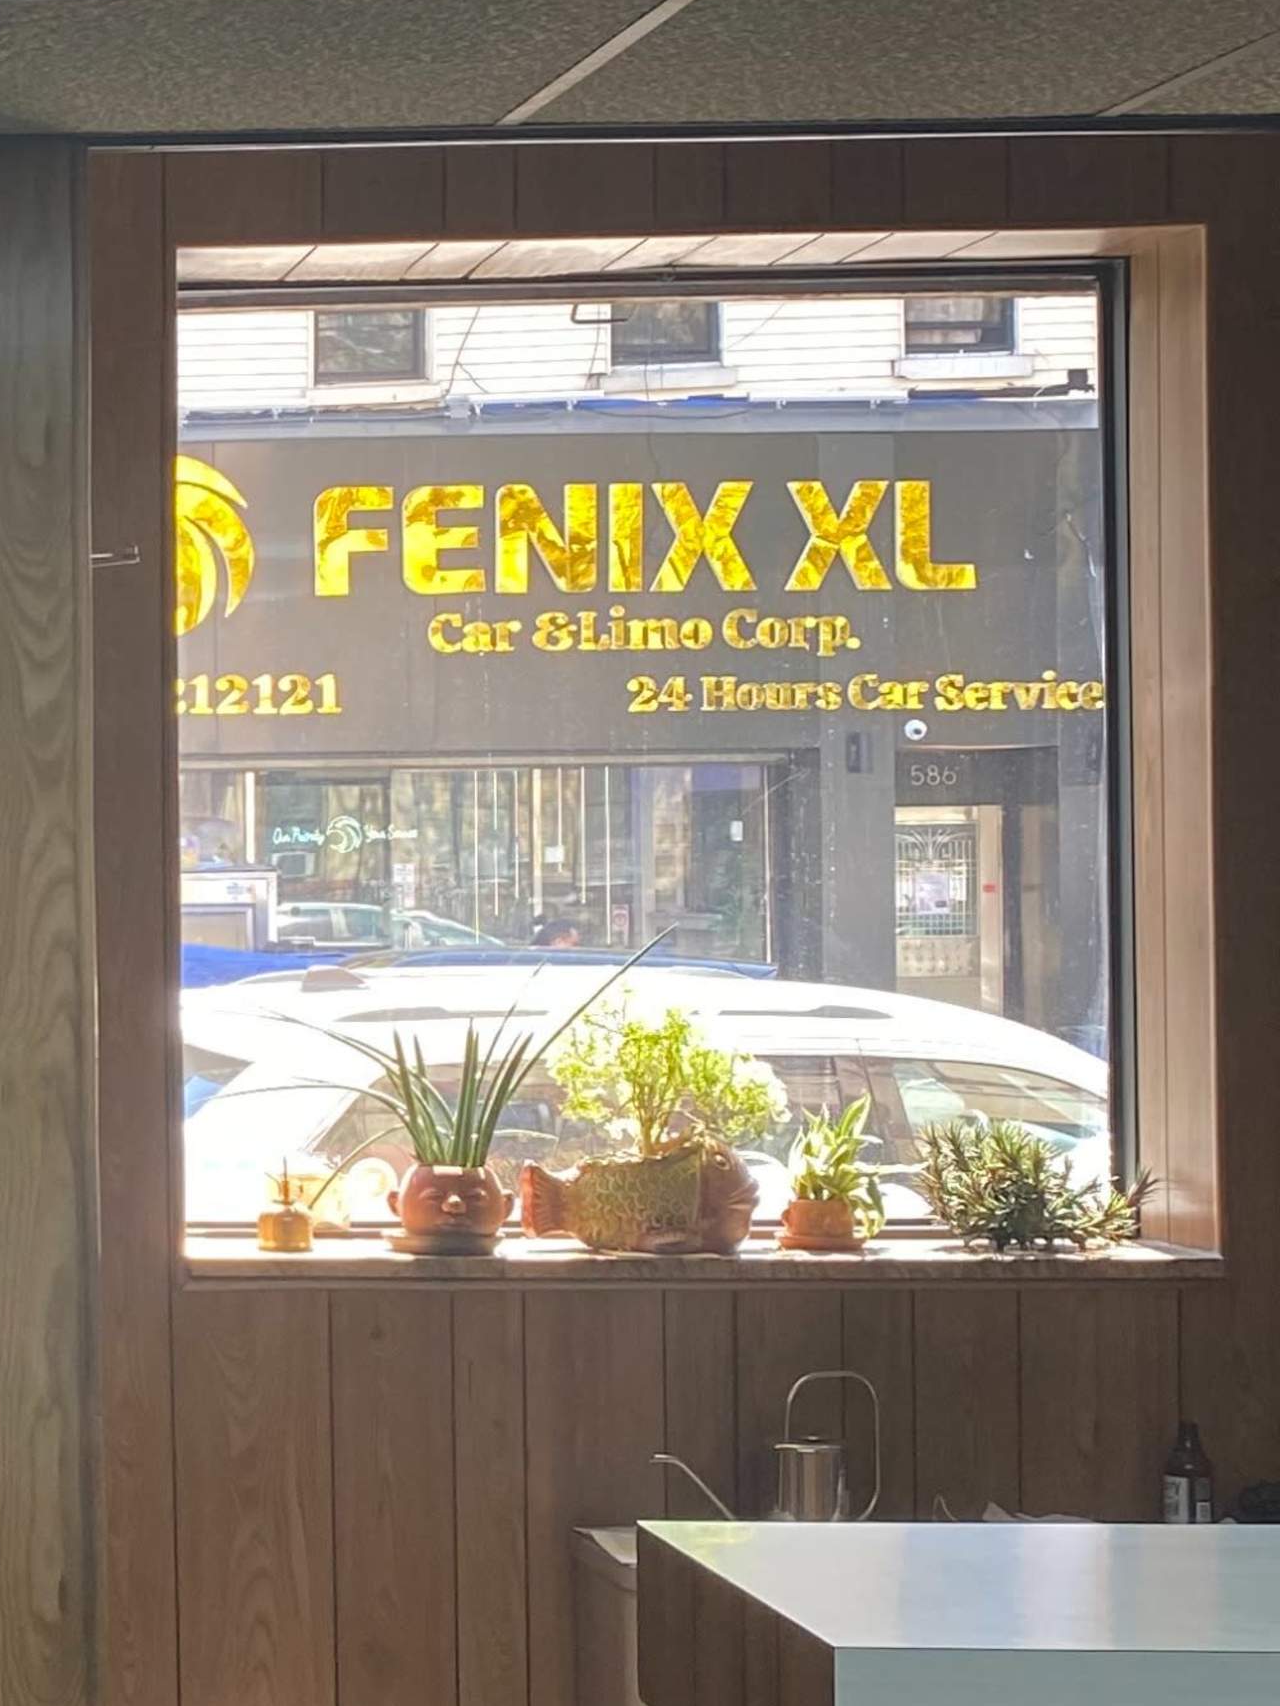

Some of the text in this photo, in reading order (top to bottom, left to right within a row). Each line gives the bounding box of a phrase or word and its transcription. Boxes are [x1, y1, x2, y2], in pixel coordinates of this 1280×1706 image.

[312, 479, 977, 597] FENIX XL
[428, 612, 515, 655] Car
[722, 608, 861, 658] Corp.
[626, 669, 1105, 715] 24 Hours Car Service
[911, 765, 957, 786] 586
